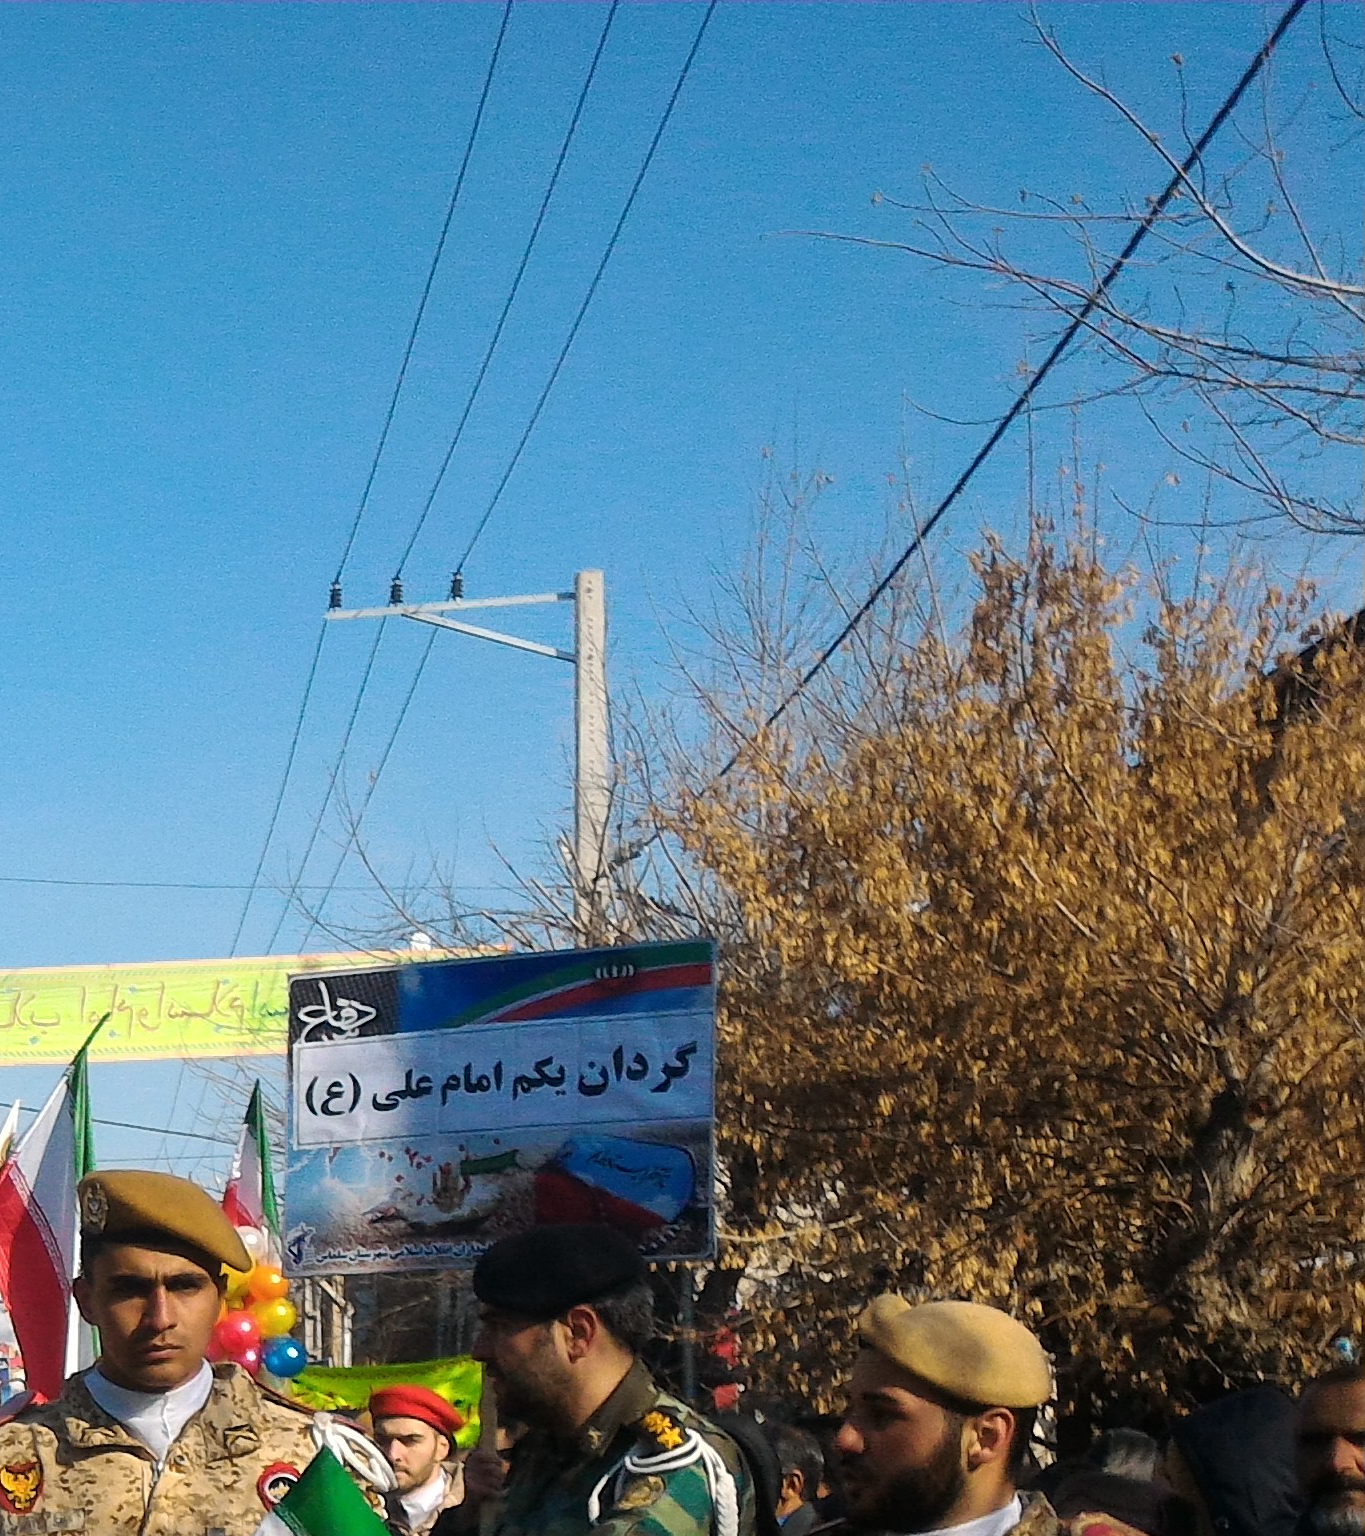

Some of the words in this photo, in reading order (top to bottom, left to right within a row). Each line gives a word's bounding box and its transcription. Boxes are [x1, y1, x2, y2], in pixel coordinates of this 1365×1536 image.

[371, 1067, 434, 1112] علی
[440, 1060, 503, 1107] امام
[512, 1055, 567, 1101] یکم
[577, 1040, 699, 1098] گردان
[304, 1072, 362, 1117] (ع)
